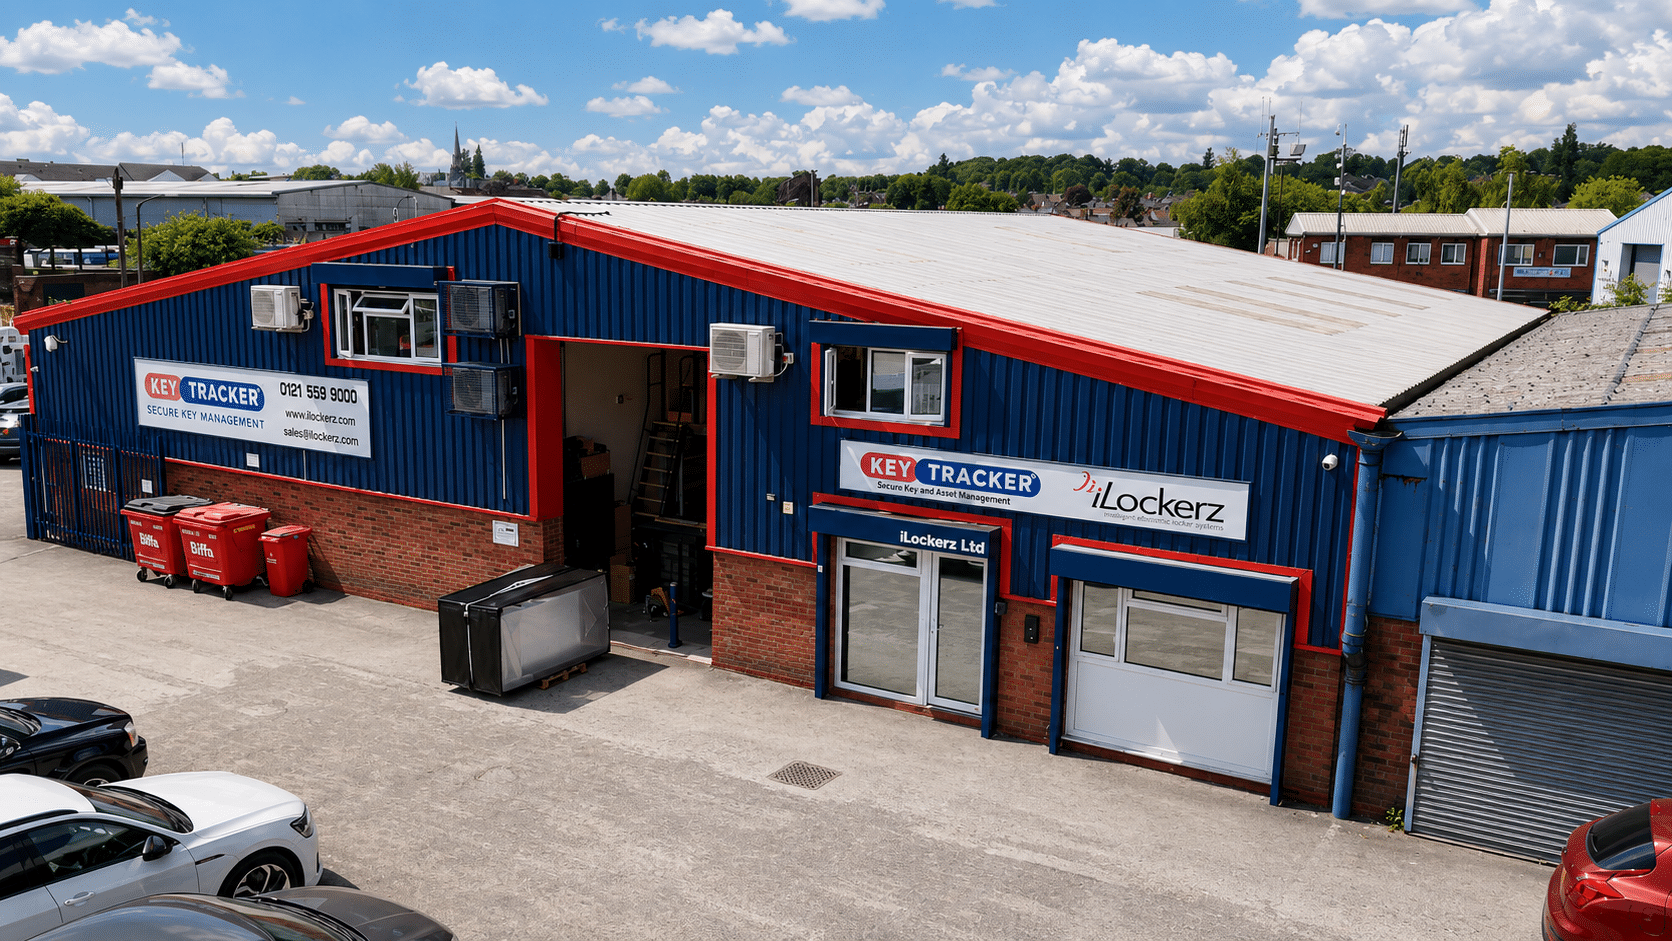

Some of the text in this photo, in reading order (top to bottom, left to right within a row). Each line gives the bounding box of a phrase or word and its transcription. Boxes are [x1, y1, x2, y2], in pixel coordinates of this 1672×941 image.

[150, 377, 177, 396] KEY
[280, 382, 358, 404] 0121 559 9000
[147, 404, 265, 429] SECURE KEY MANAGEMENT
[285, 409, 356, 426] www.ilockerz.com
[283, 427, 359, 447] sales@ilockerz.com
[870, 456, 912, 478] KEY
[904, 484, 918, 495] Key
[920, 486, 935, 495] and
[958, 491, 1011, 505] Management
[1091, 481, 1225, 523] iLockerz
[190, 541, 215, 558] Biffa
[900, 530, 985, 555] iLockerz Ltd
